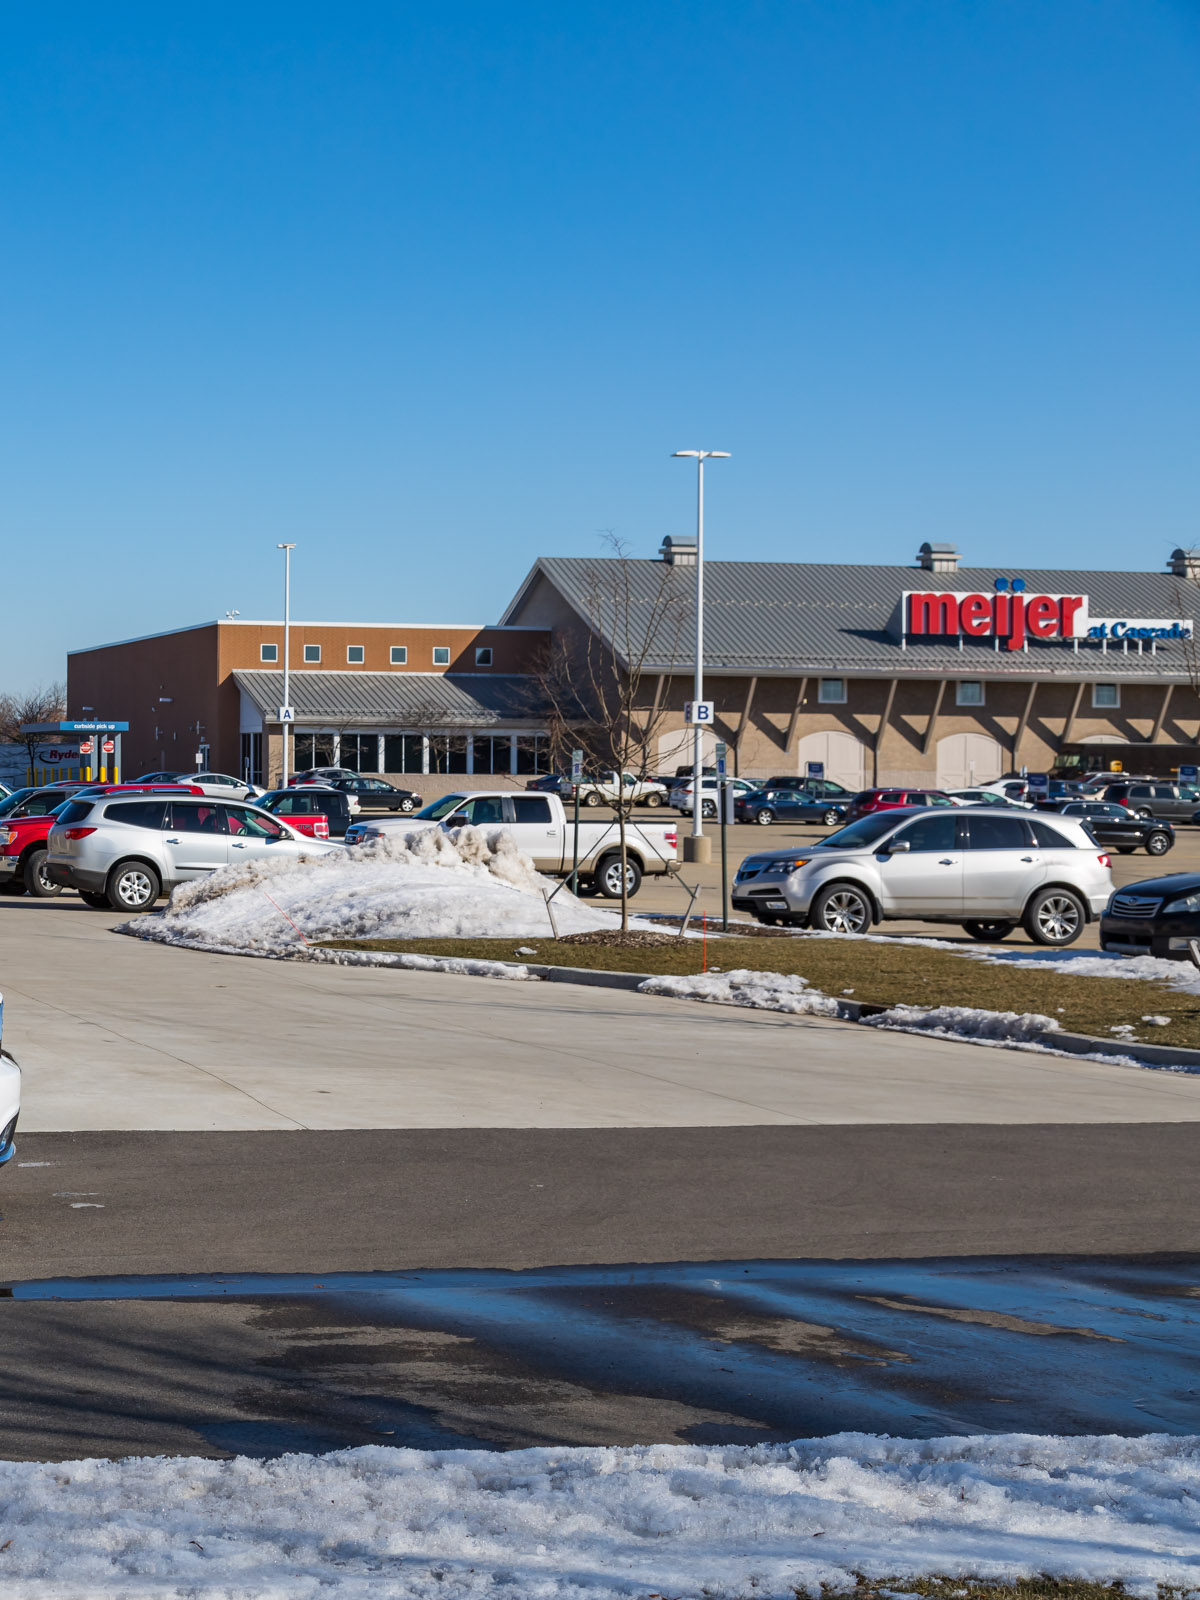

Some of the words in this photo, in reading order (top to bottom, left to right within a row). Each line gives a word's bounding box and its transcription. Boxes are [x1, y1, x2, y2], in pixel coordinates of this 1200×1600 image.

[908, 577, 1083, 650] meijer
[1087, 622, 1108, 638] at
[1110, 621, 1192, 639] Cascade
[283, 709, 292, 719] A
[697, 705, 709, 720] B
